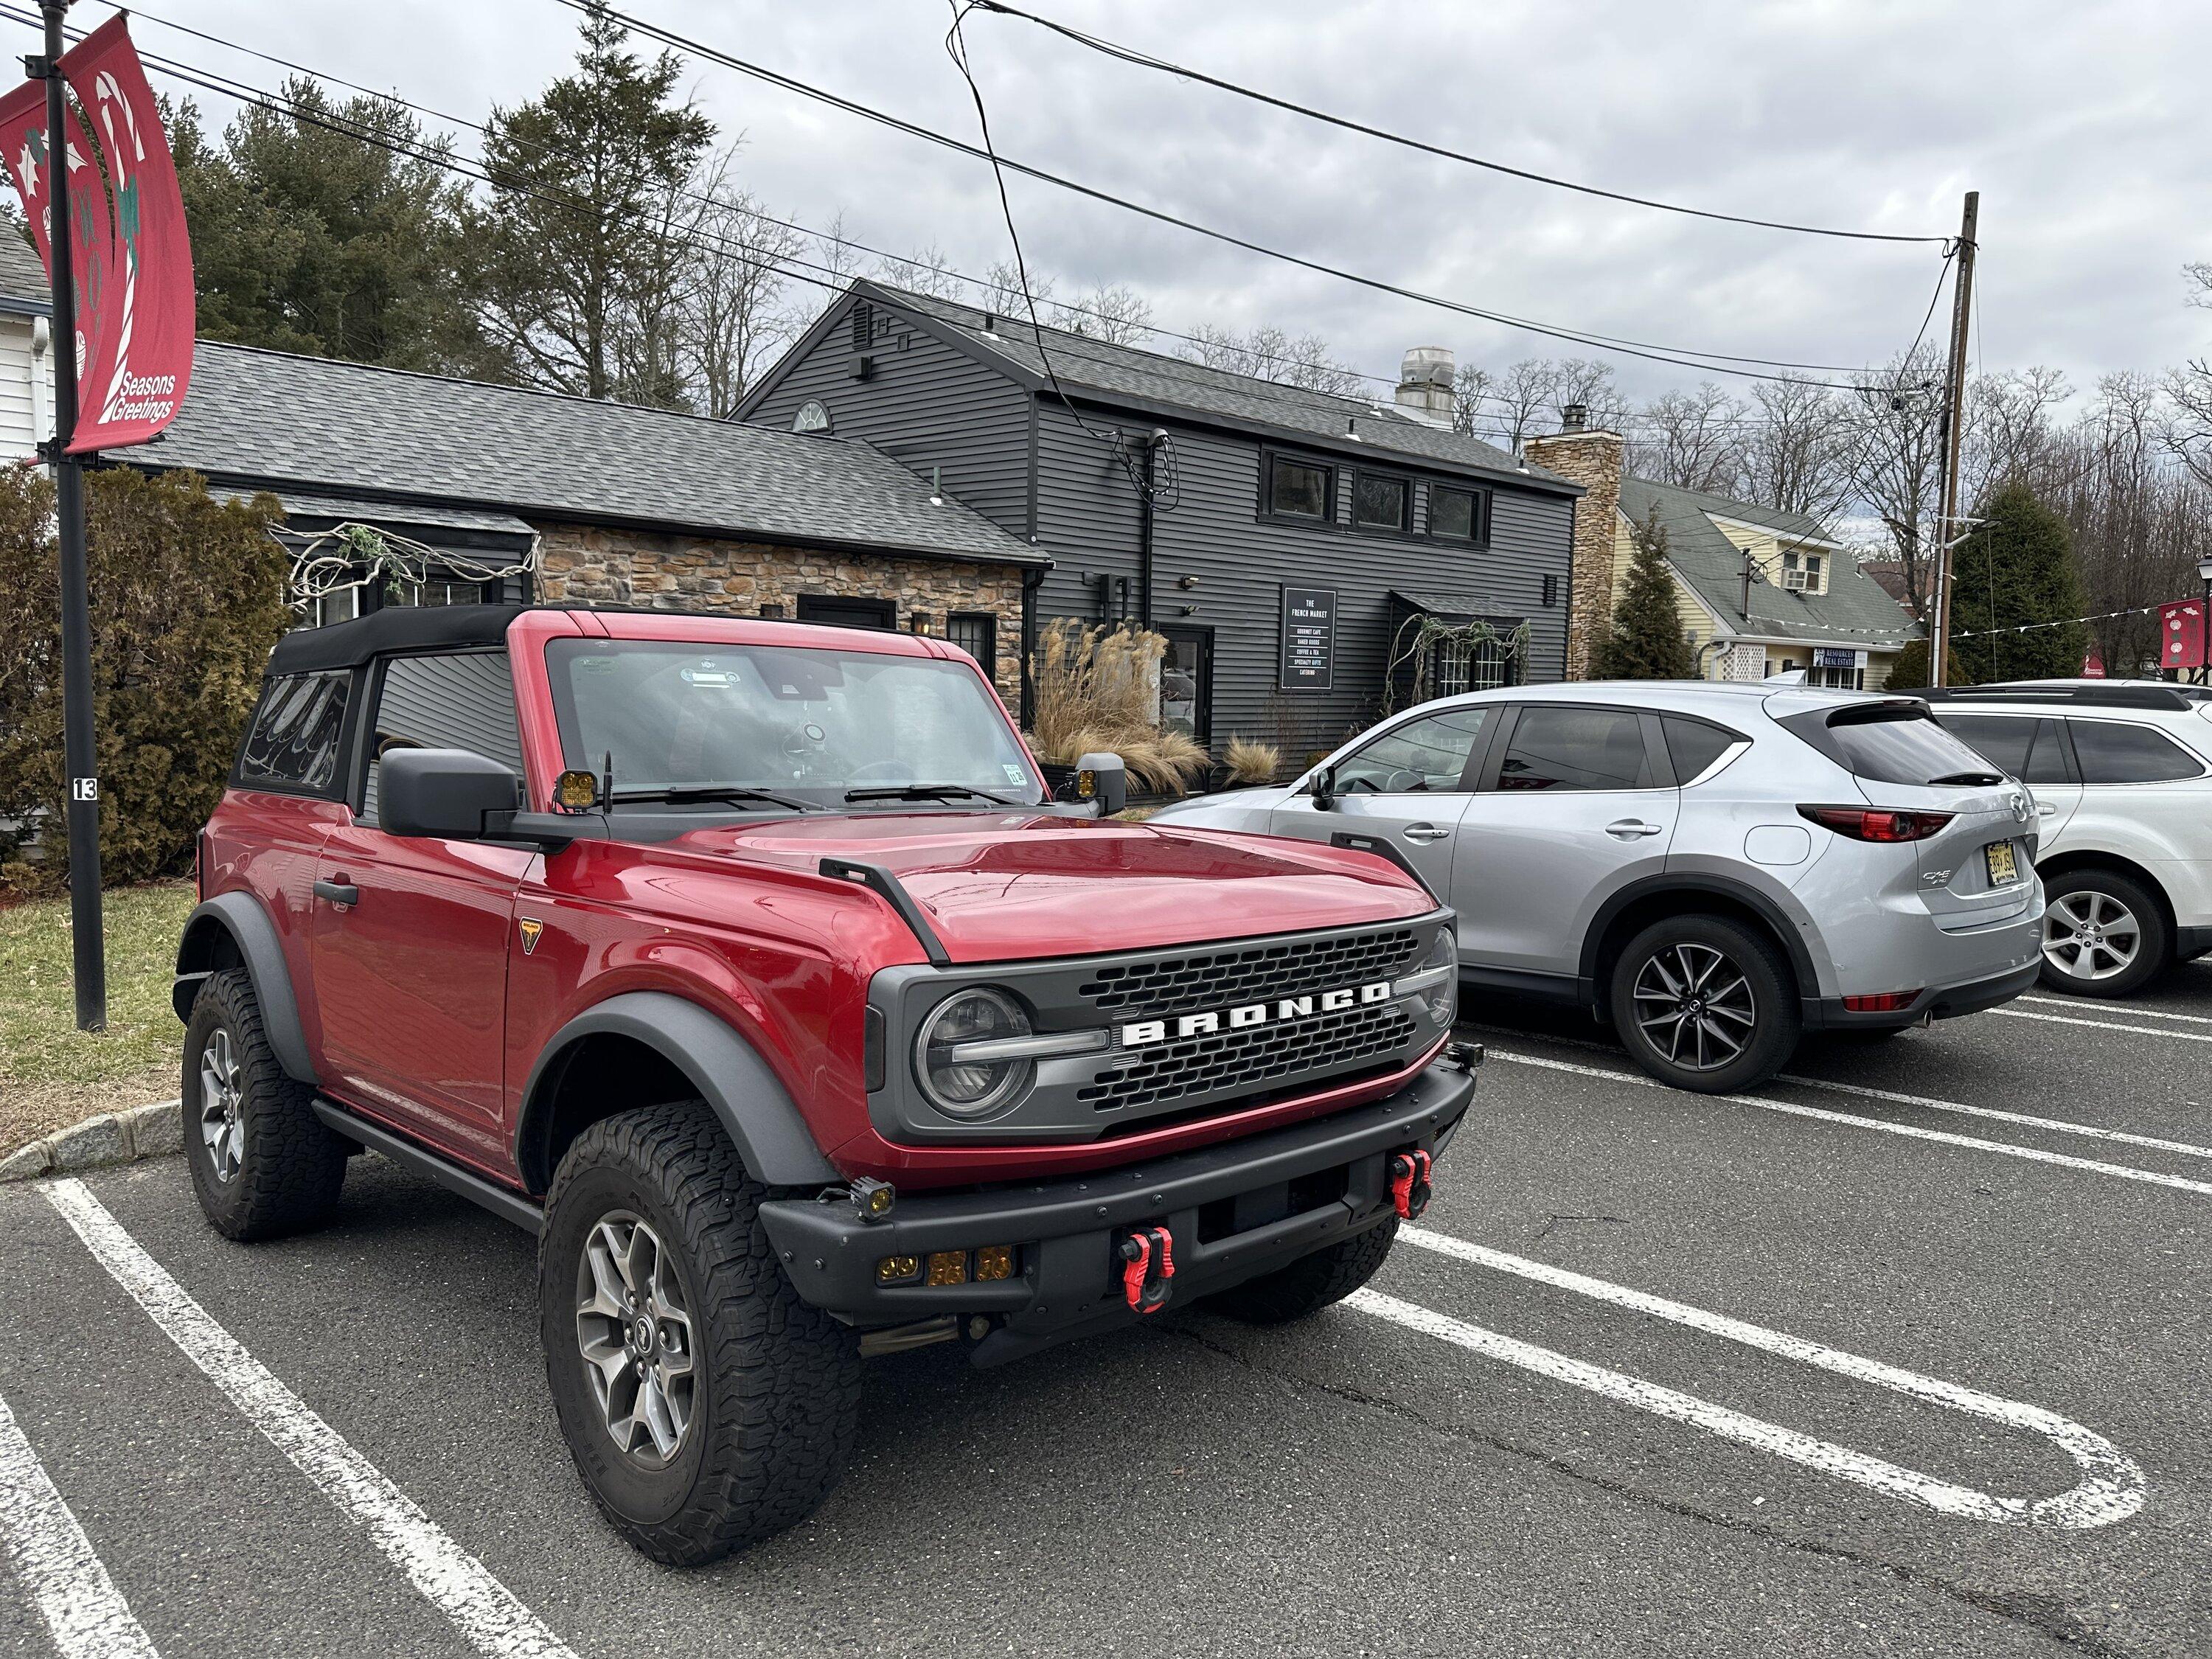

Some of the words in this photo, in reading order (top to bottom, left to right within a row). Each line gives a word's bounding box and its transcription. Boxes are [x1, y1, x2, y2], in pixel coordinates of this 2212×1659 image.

[120, 371, 175, 396] Seasons
[111, 396, 174, 424] Greetings
[1306, 599, 1315, 608] THE
[1292, 608, 1309, 617] FRENCH
[1310, 610, 1327, 619] MARKET
[1826, 650, 1853, 658] RESOURCES
[1825, 657, 1836, 665] REAL
[1837, 658, 1854, 667] ESTATE
[75, 779, 97, 799] 13
[1122, 981, 1390, 1046] BRONCO
